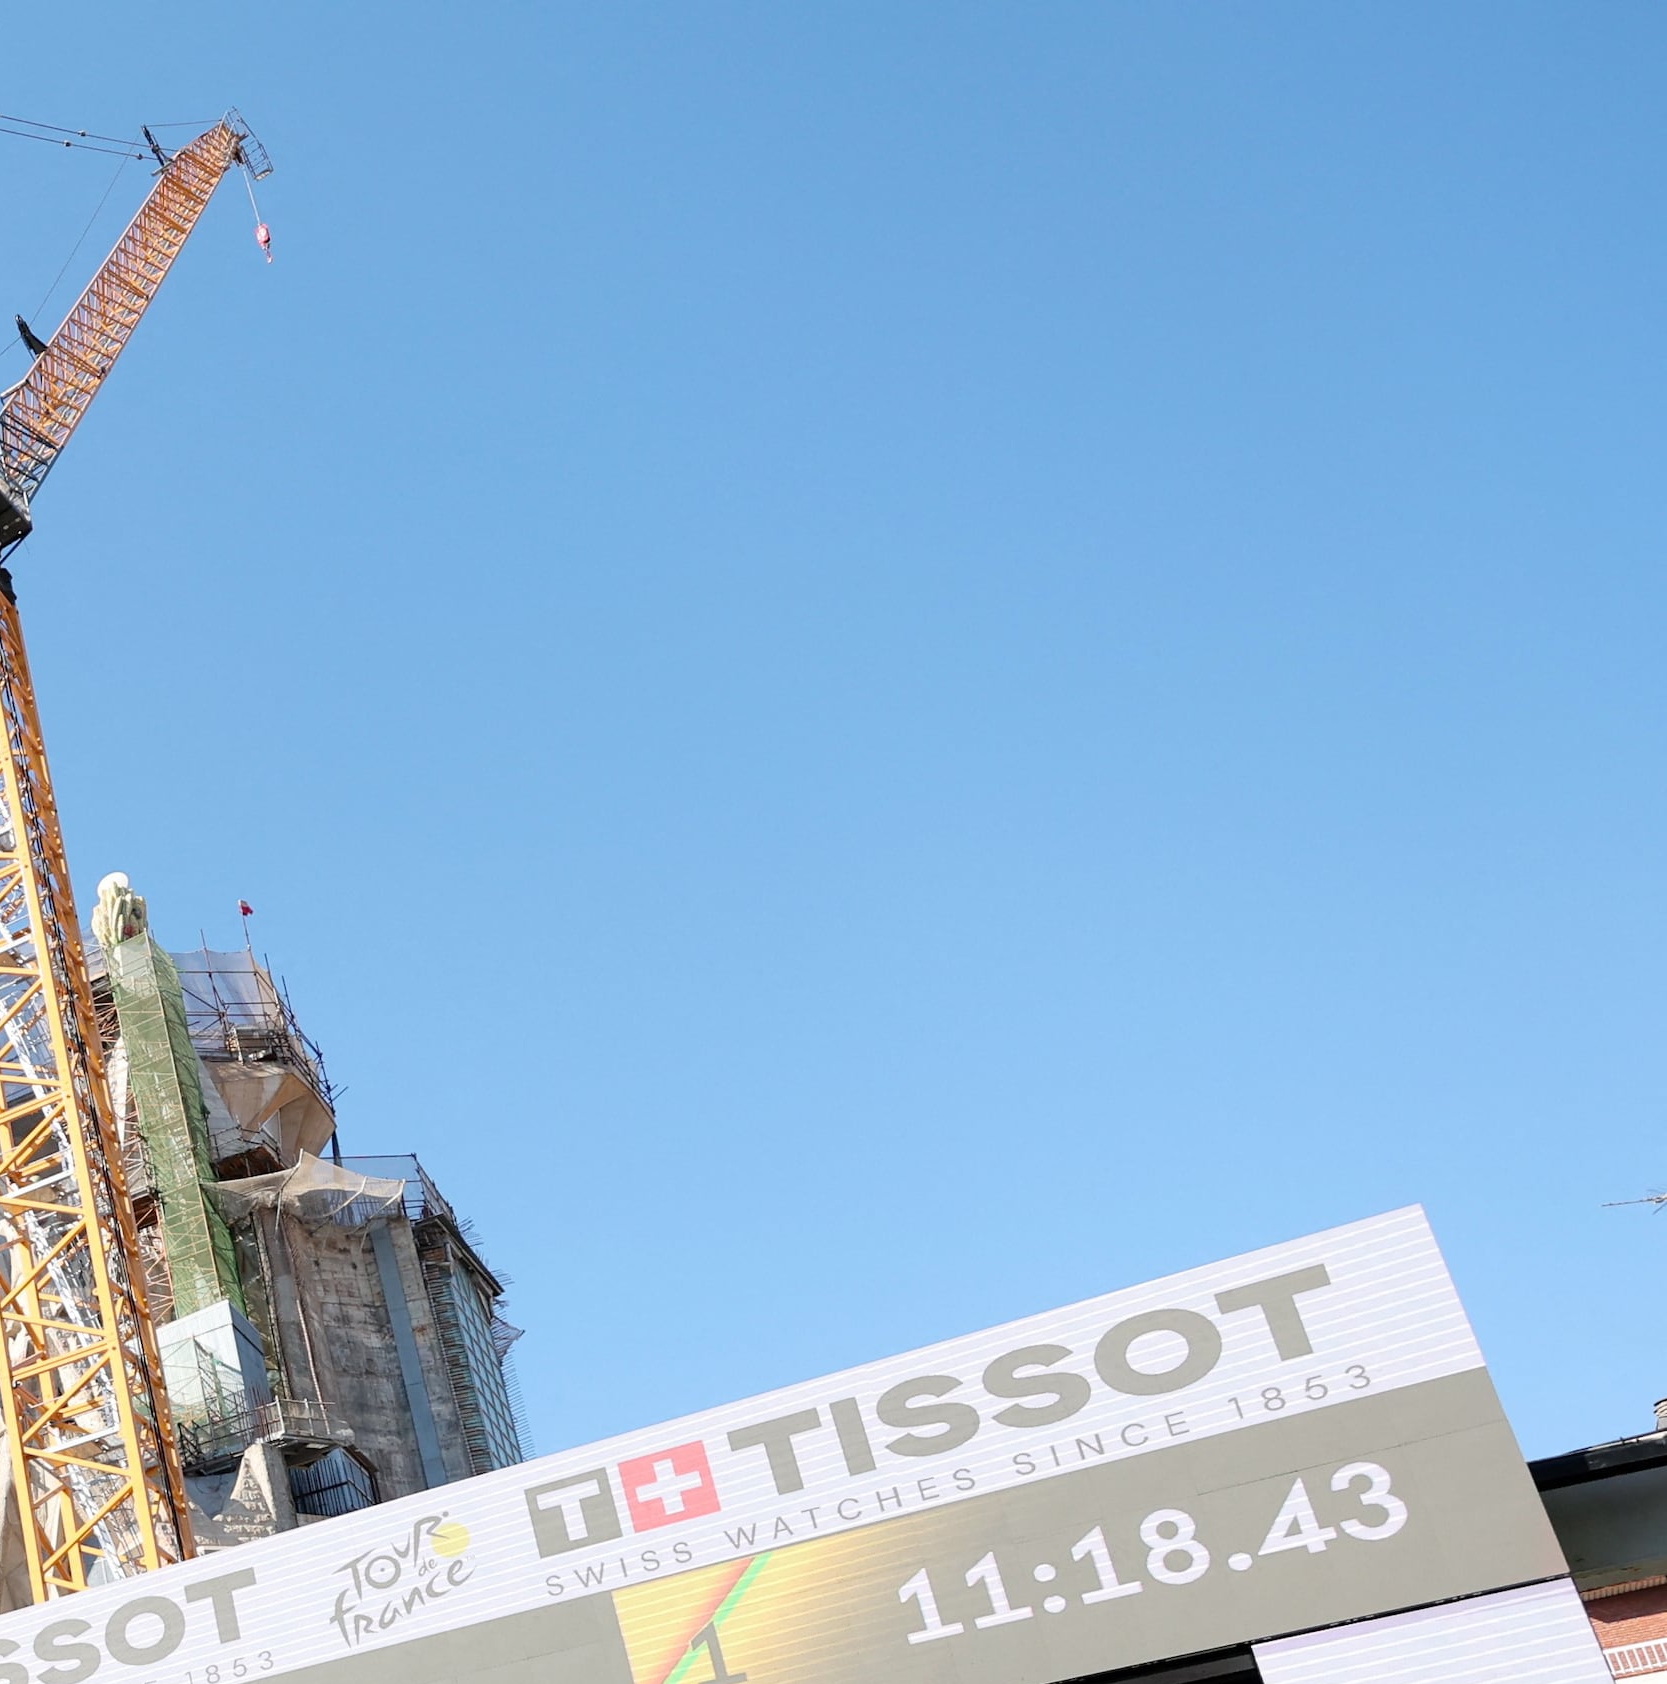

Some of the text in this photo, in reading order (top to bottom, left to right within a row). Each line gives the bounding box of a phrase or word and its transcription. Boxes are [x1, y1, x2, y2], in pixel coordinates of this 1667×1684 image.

[728, 1264, 1331, 1495] TISSOT
[330, 1511, 450, 1590] TOUR
[418, 1555, 438, 1577] de
[546, 1364, 1373, 1598] SWISS WATCHES SINCE 1853
[897, 1461, 1409, 1646] 11:18.43
